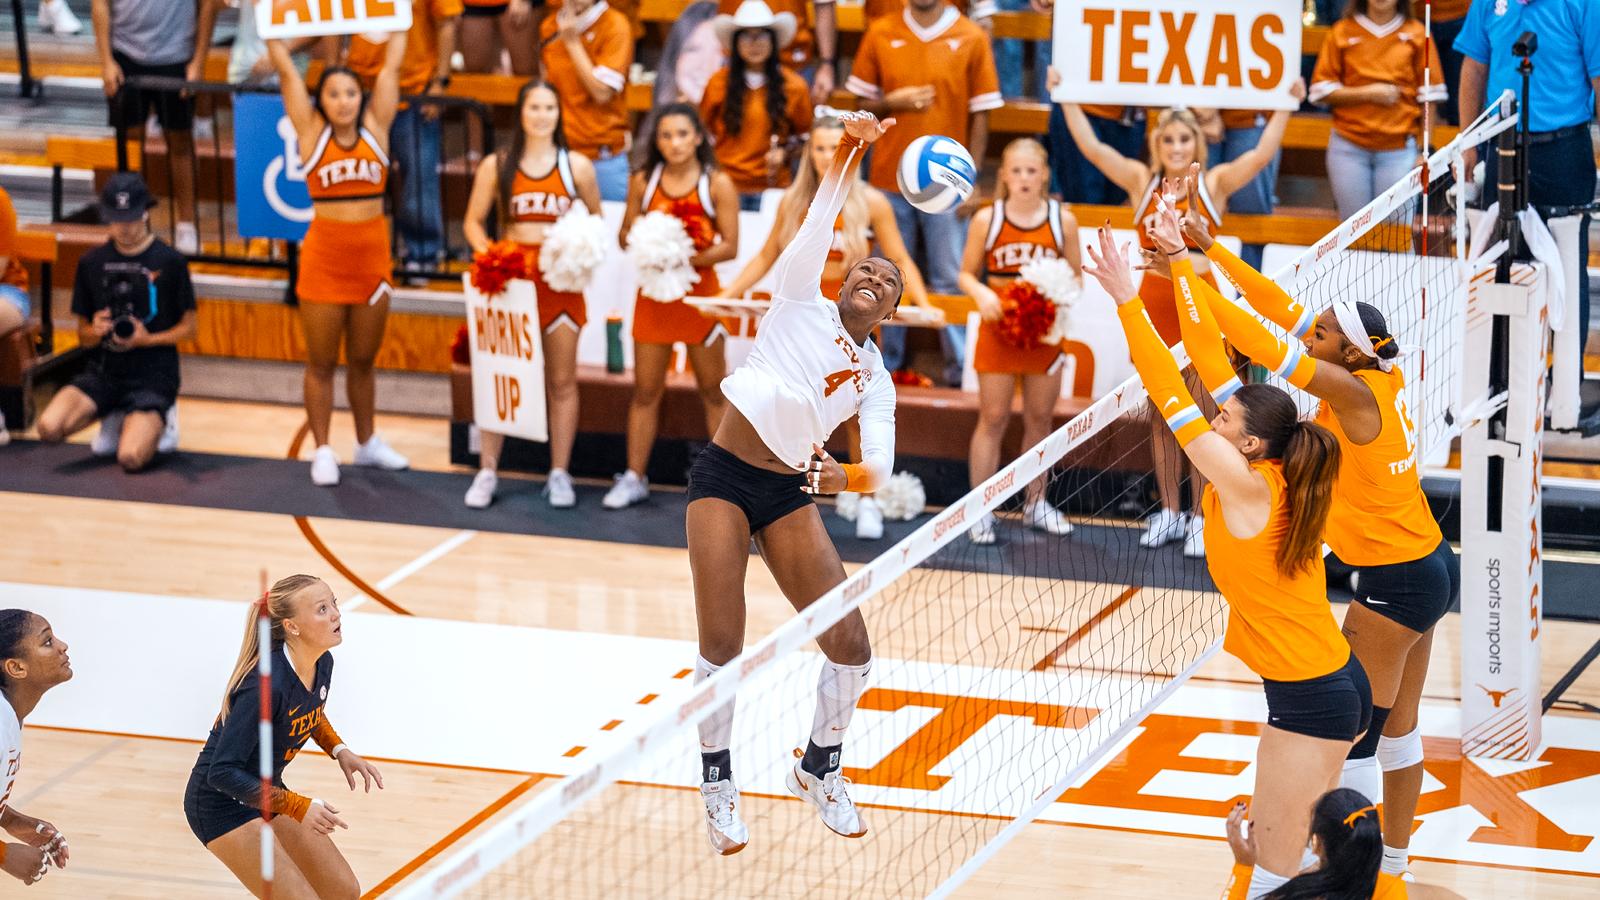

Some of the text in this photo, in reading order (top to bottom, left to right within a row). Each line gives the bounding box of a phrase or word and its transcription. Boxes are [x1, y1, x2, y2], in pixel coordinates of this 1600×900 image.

[1083, 8, 1285, 91] TEXAS
[318, 158, 382, 188] TEXAS
[1178, 275, 1201, 325] ROCKY TOP
[475, 306, 532, 361] HORNS
[494, 373, 521, 423] UP
[824, 369, 854, 398] 4
[1067, 411, 1094, 445] TEXAS
[1486, 558, 1502, 674] sports imports
[288, 705, 321, 737] TEXA
